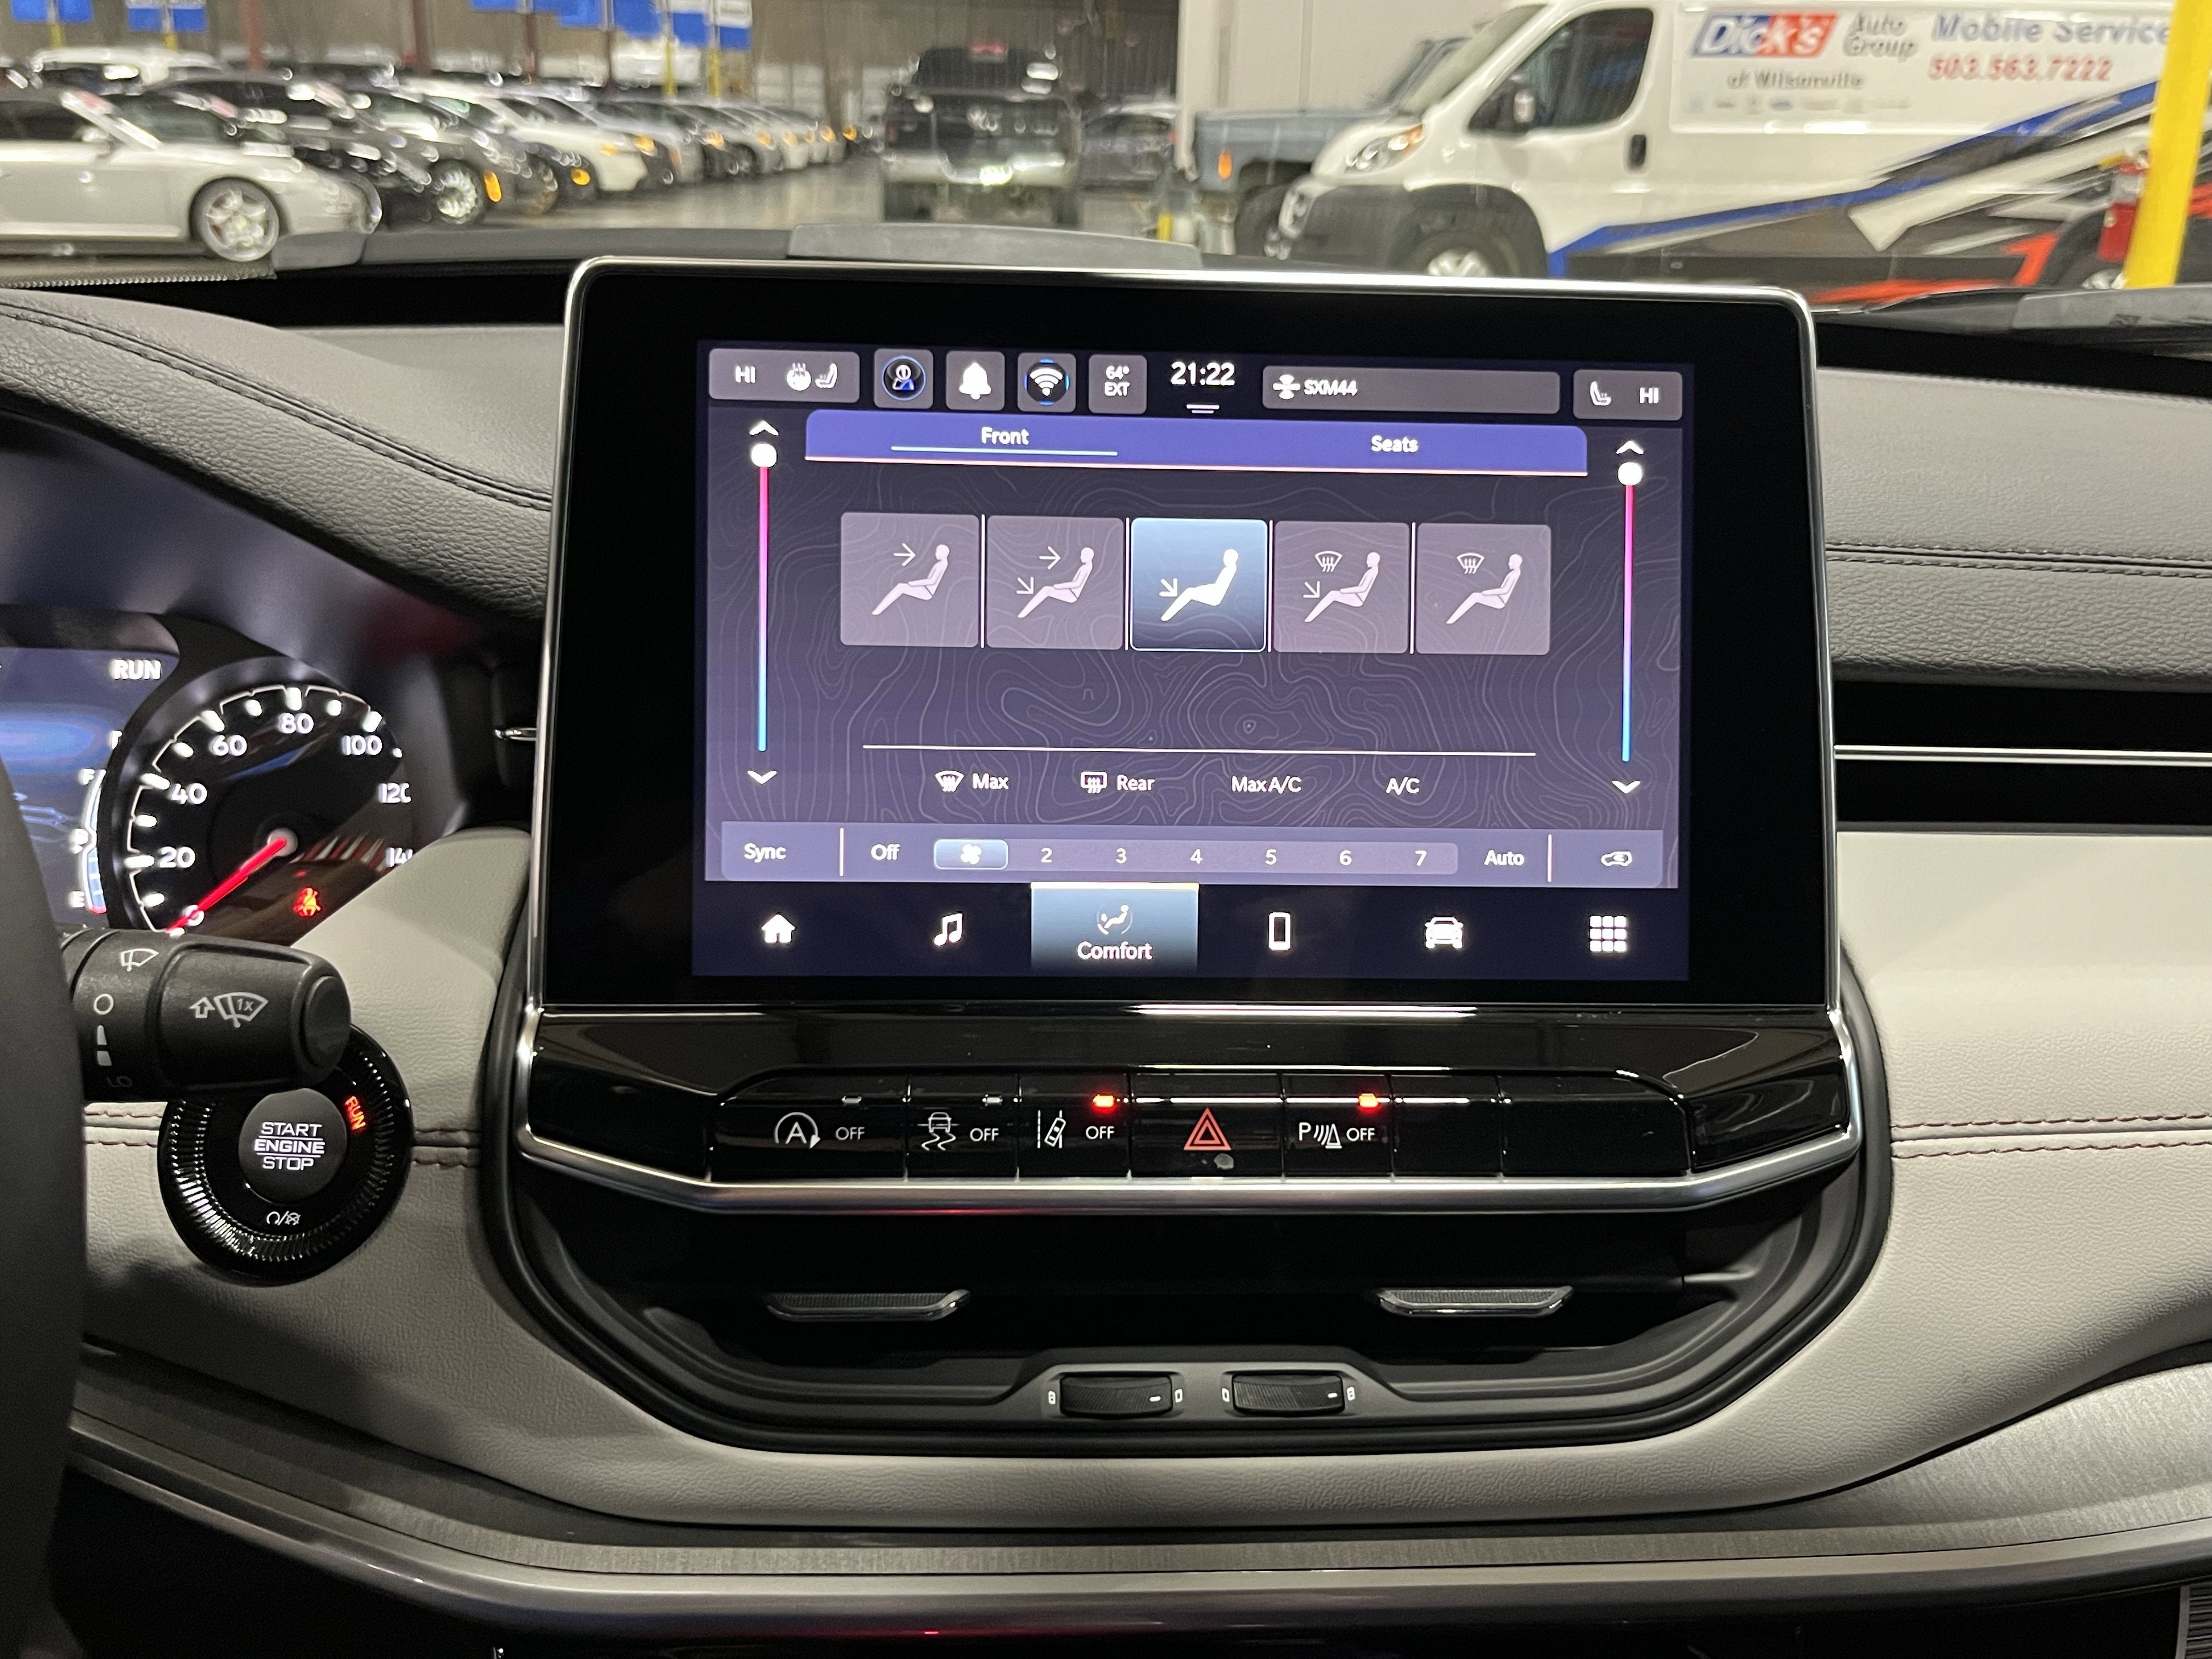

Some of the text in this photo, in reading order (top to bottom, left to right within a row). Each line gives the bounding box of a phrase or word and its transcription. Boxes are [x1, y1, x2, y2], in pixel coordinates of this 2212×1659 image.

[1850, 12, 1908, 36] Auto
[1932, 13, 2044, 42] Mobile
[1843, 35, 1918, 62] Group
[735, 365, 756, 383] HI
[1170, 361, 1235, 386] 21:22
[1104, 382, 1130, 397] EXT
[1304, 380, 1358, 396] SXM44
[1639, 387, 1660, 404] HI
[981, 426, 1029, 446] Front
[1371, 435, 1419, 453] Seats
[111, 659, 161, 680] RUN
[280, 713, 314, 735] 80
[212, 735, 247, 757] 60
[345, 735, 382, 756] 100
[80, 768, 95, 785] F
[972, 773, 1009, 790] Max
[1117, 774, 1156, 791] Rear
[1231, 775, 1302, 794] Max A/C
[1385, 776, 1420, 795] A/C
[170, 783, 207, 805] 40
[159, 846, 196, 868] 20
[744, 842, 787, 864] Sync
[871, 844, 901, 861] Off
[1041, 847, 1427, 867] 2 3 4 5 6 7
[1483, 850, 1525, 866] Auto
[69, 890, 84, 908] E
[1077, 941, 1153, 960] Comfort
[345, 1096, 366, 1131] RUN
[261, 1121, 323, 1136] START
[836, 1127, 865, 1141] OFF
[970, 1127, 999, 1142] OFF
[1085, 1126, 1115, 1140] OFF
[1299, 1122, 1375, 1142] P OFF
[254, 1139, 325, 1154] ENGINE
[262, 1156, 314, 1171] STOP
